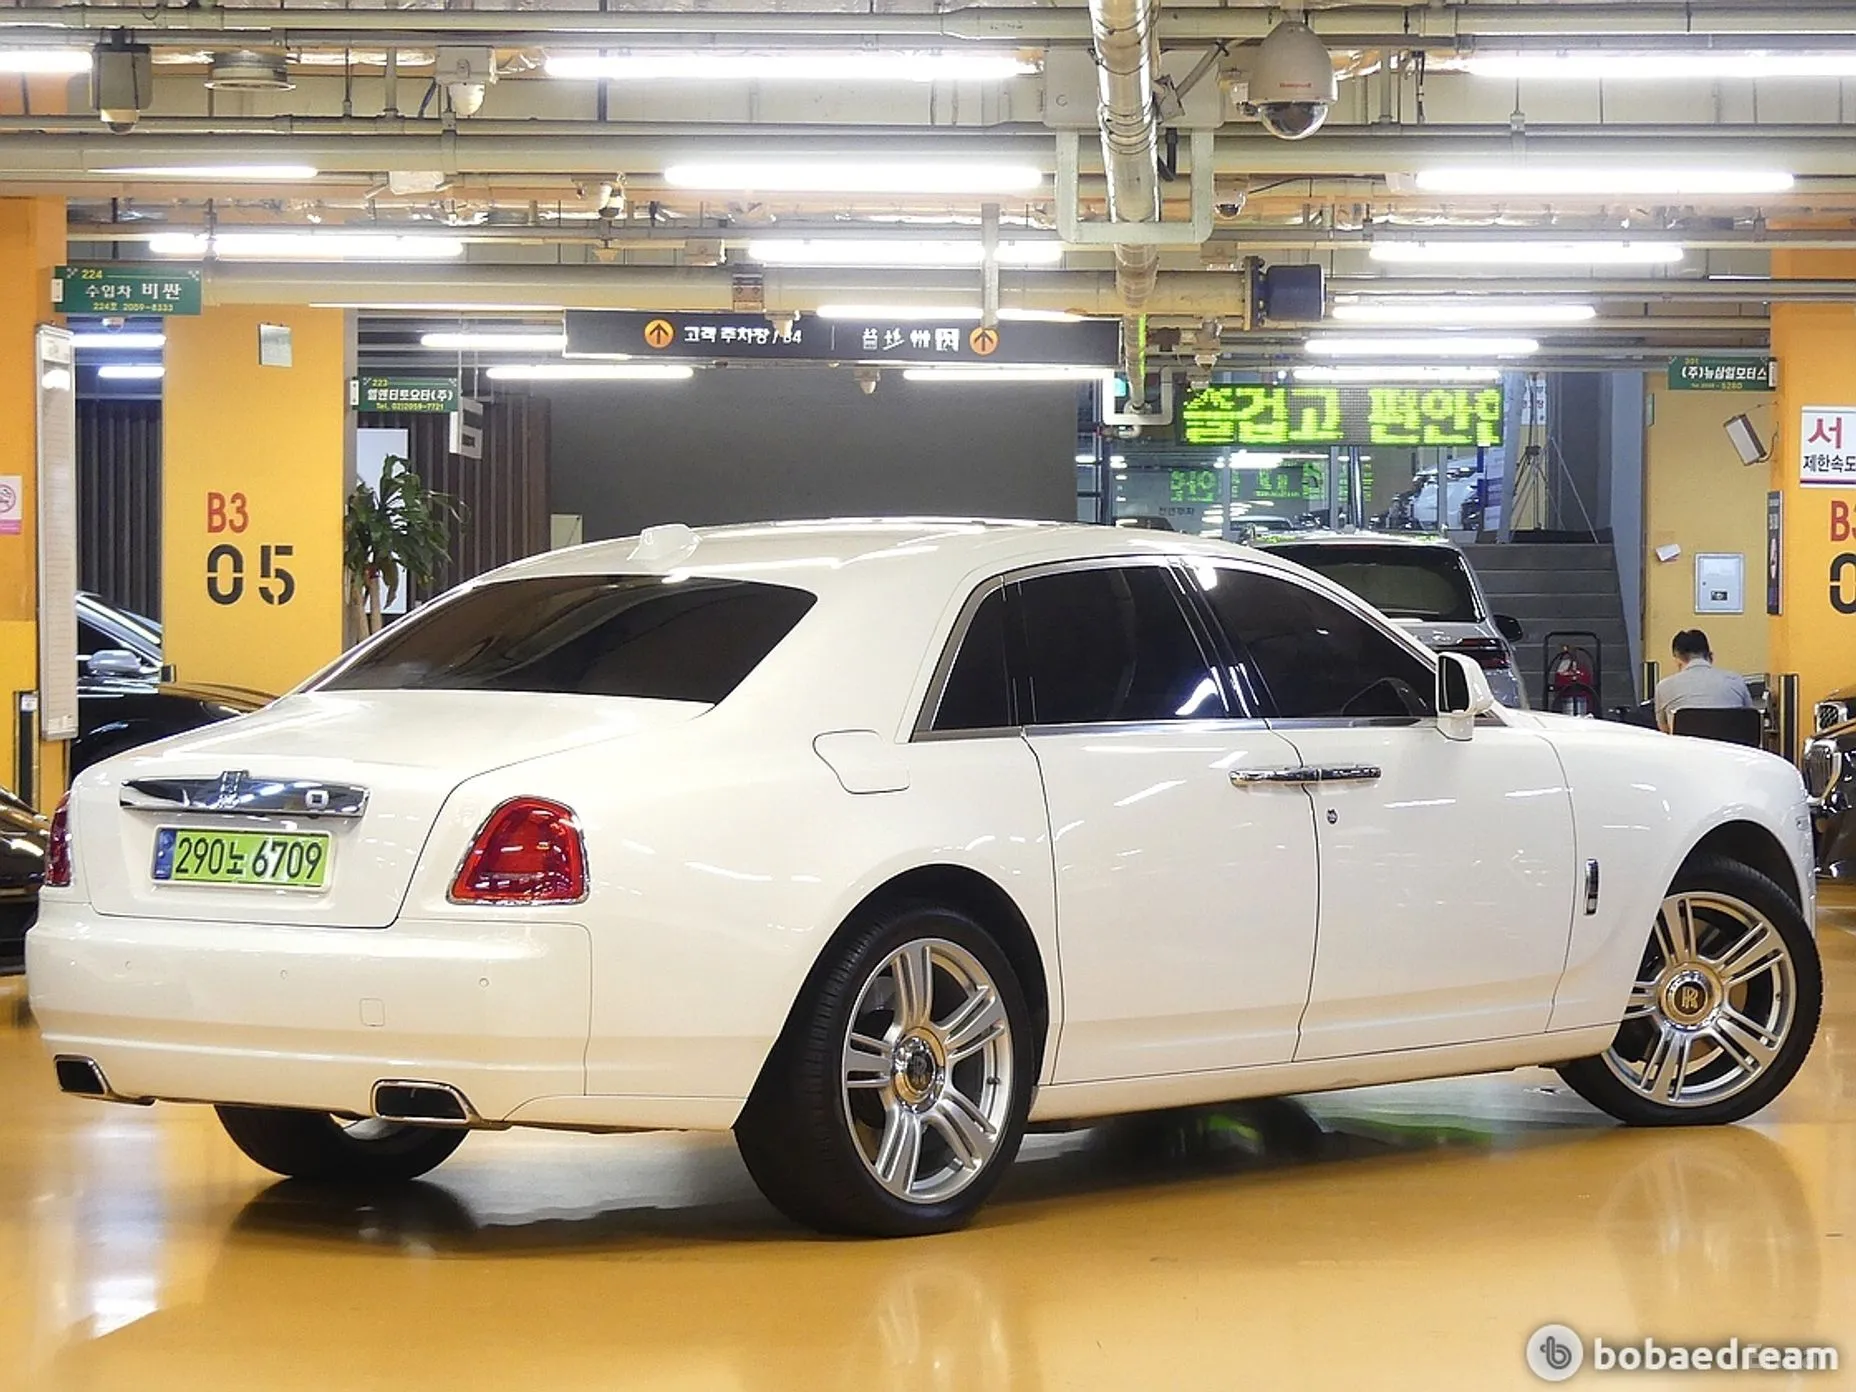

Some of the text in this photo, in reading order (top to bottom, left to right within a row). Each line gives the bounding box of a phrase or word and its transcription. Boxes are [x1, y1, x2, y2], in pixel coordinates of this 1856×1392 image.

[81, 269, 103, 279] 224
[86, 284, 132, 299] 수입차
[684, 326, 717, 342] 고객
[720, 326, 770, 344] 주차장
[1808, 417, 1843, 449] 서
[1803, 454, 1856, 473] 제한속도
[207, 492, 249, 533] B3
